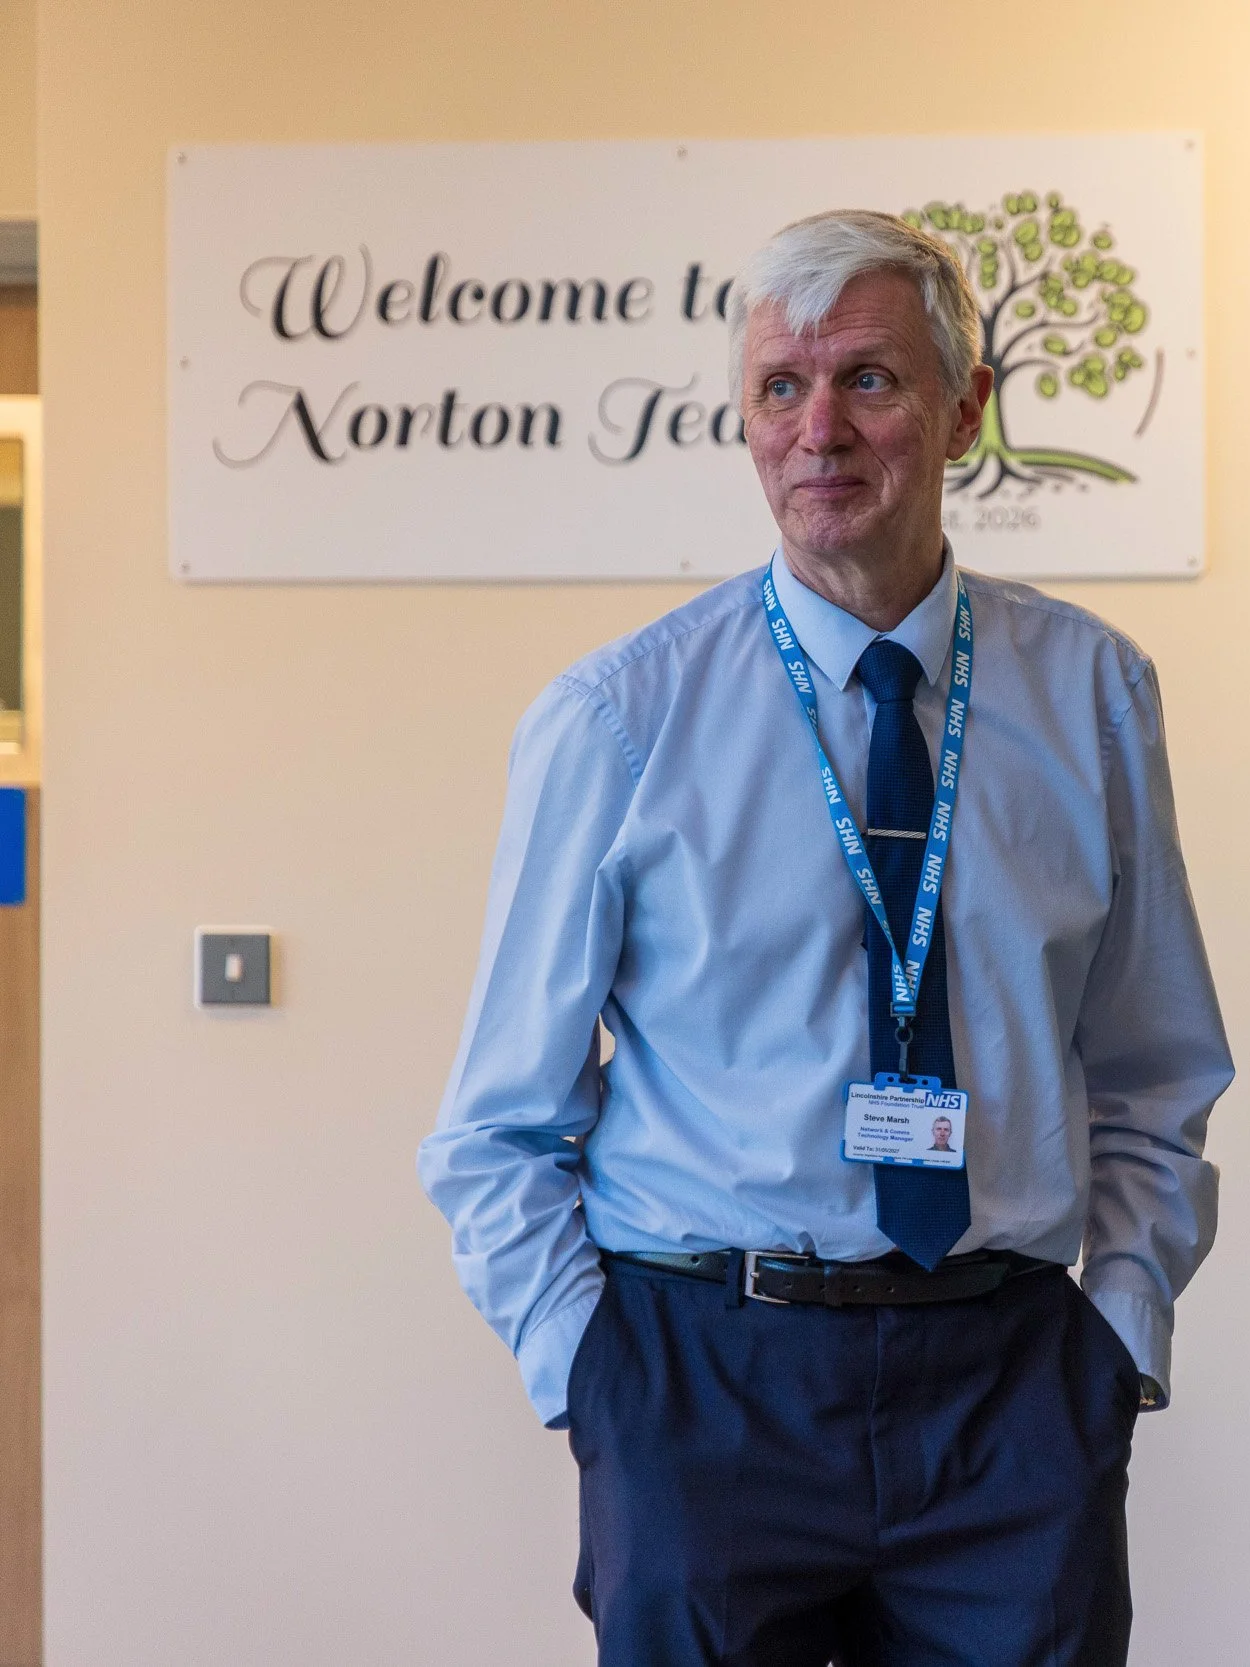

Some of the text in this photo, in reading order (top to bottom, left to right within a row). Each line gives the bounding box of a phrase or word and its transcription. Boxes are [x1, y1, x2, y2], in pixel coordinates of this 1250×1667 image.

[239, 245, 653, 343] Welcome
[212, 373, 749, 468] Norton Tea
[763, 578, 777, 611] NHS
[772, 618, 794, 651] NHS
[959, 605, 971, 641] NHS
[788, 660, 812, 694] NHS
[954, 650, 970, 688] NHS
[948, 698, 965, 738] NHS
[821, 766, 841, 804] NHS
[941, 750, 959, 790] NHS
[835, 817, 862, 855] NHS
[933, 800, 951, 842] NHS
[856, 868, 883, 905] NHS
[923, 853, 942, 895] NHS
[913, 906, 932, 948] NHS
[893, 964, 910, 1002] NHS
[850, 1092, 925, 1104] Lincolnshire Partnership
[926, 1093, 960, 1109] NHS
[863, 1113, 910, 1124] Steve Marsh
